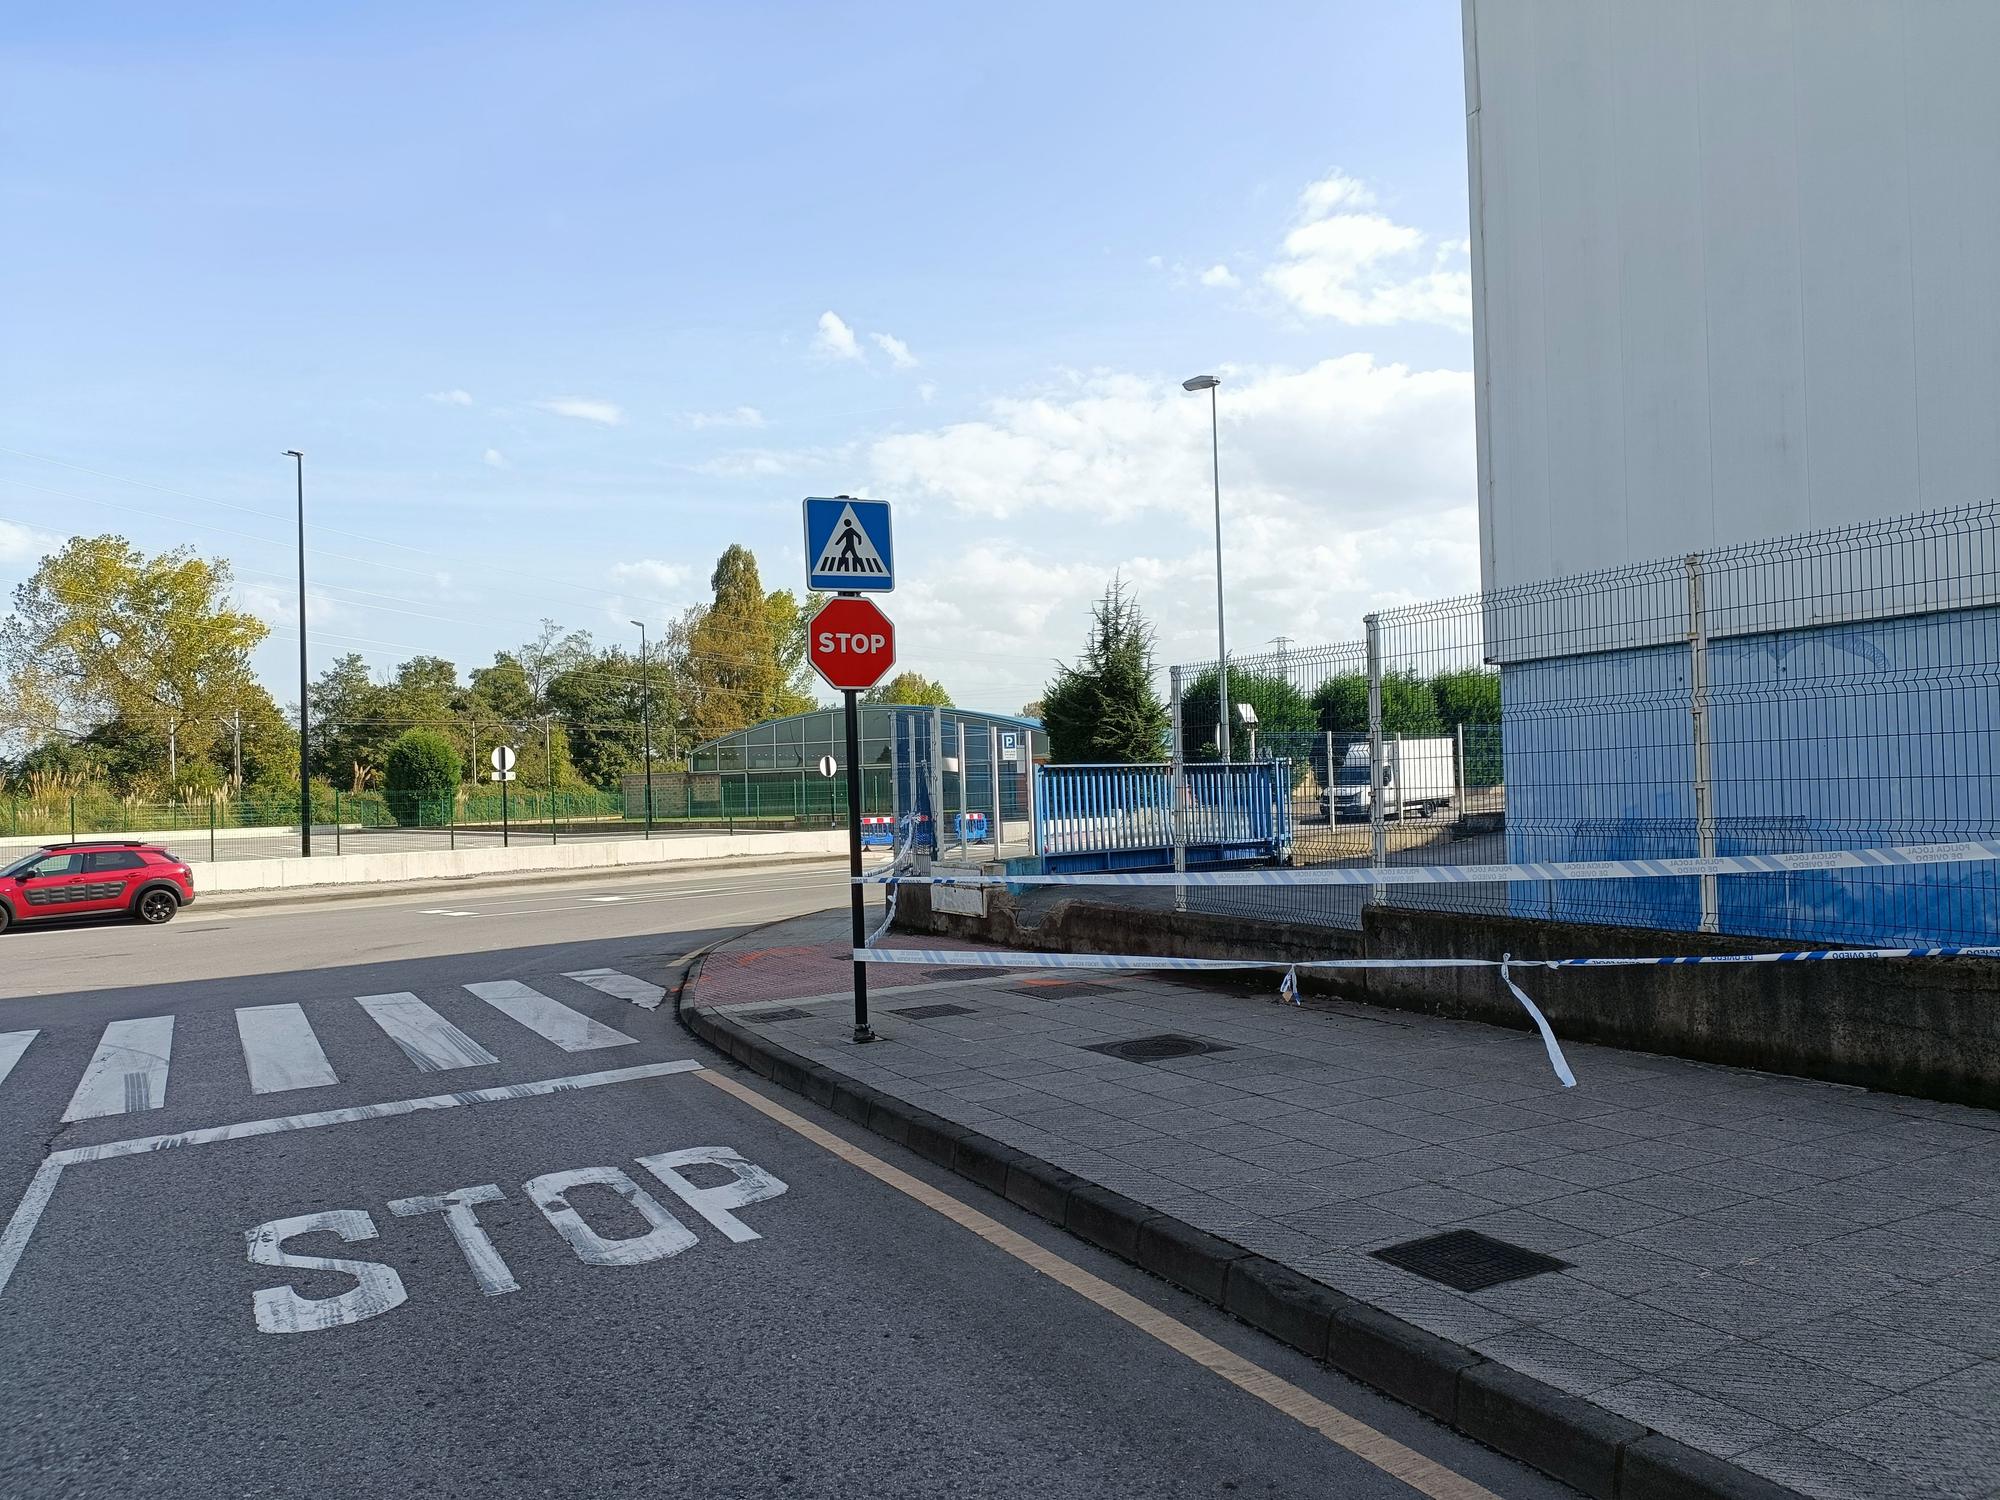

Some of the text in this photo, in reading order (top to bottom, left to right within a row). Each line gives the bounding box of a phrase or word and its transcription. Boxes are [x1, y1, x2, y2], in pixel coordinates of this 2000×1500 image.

[818, 632, 886, 654] STOP
[1006, 737, 1013, 748] P
[244, 1146, 790, 1334] STOP
